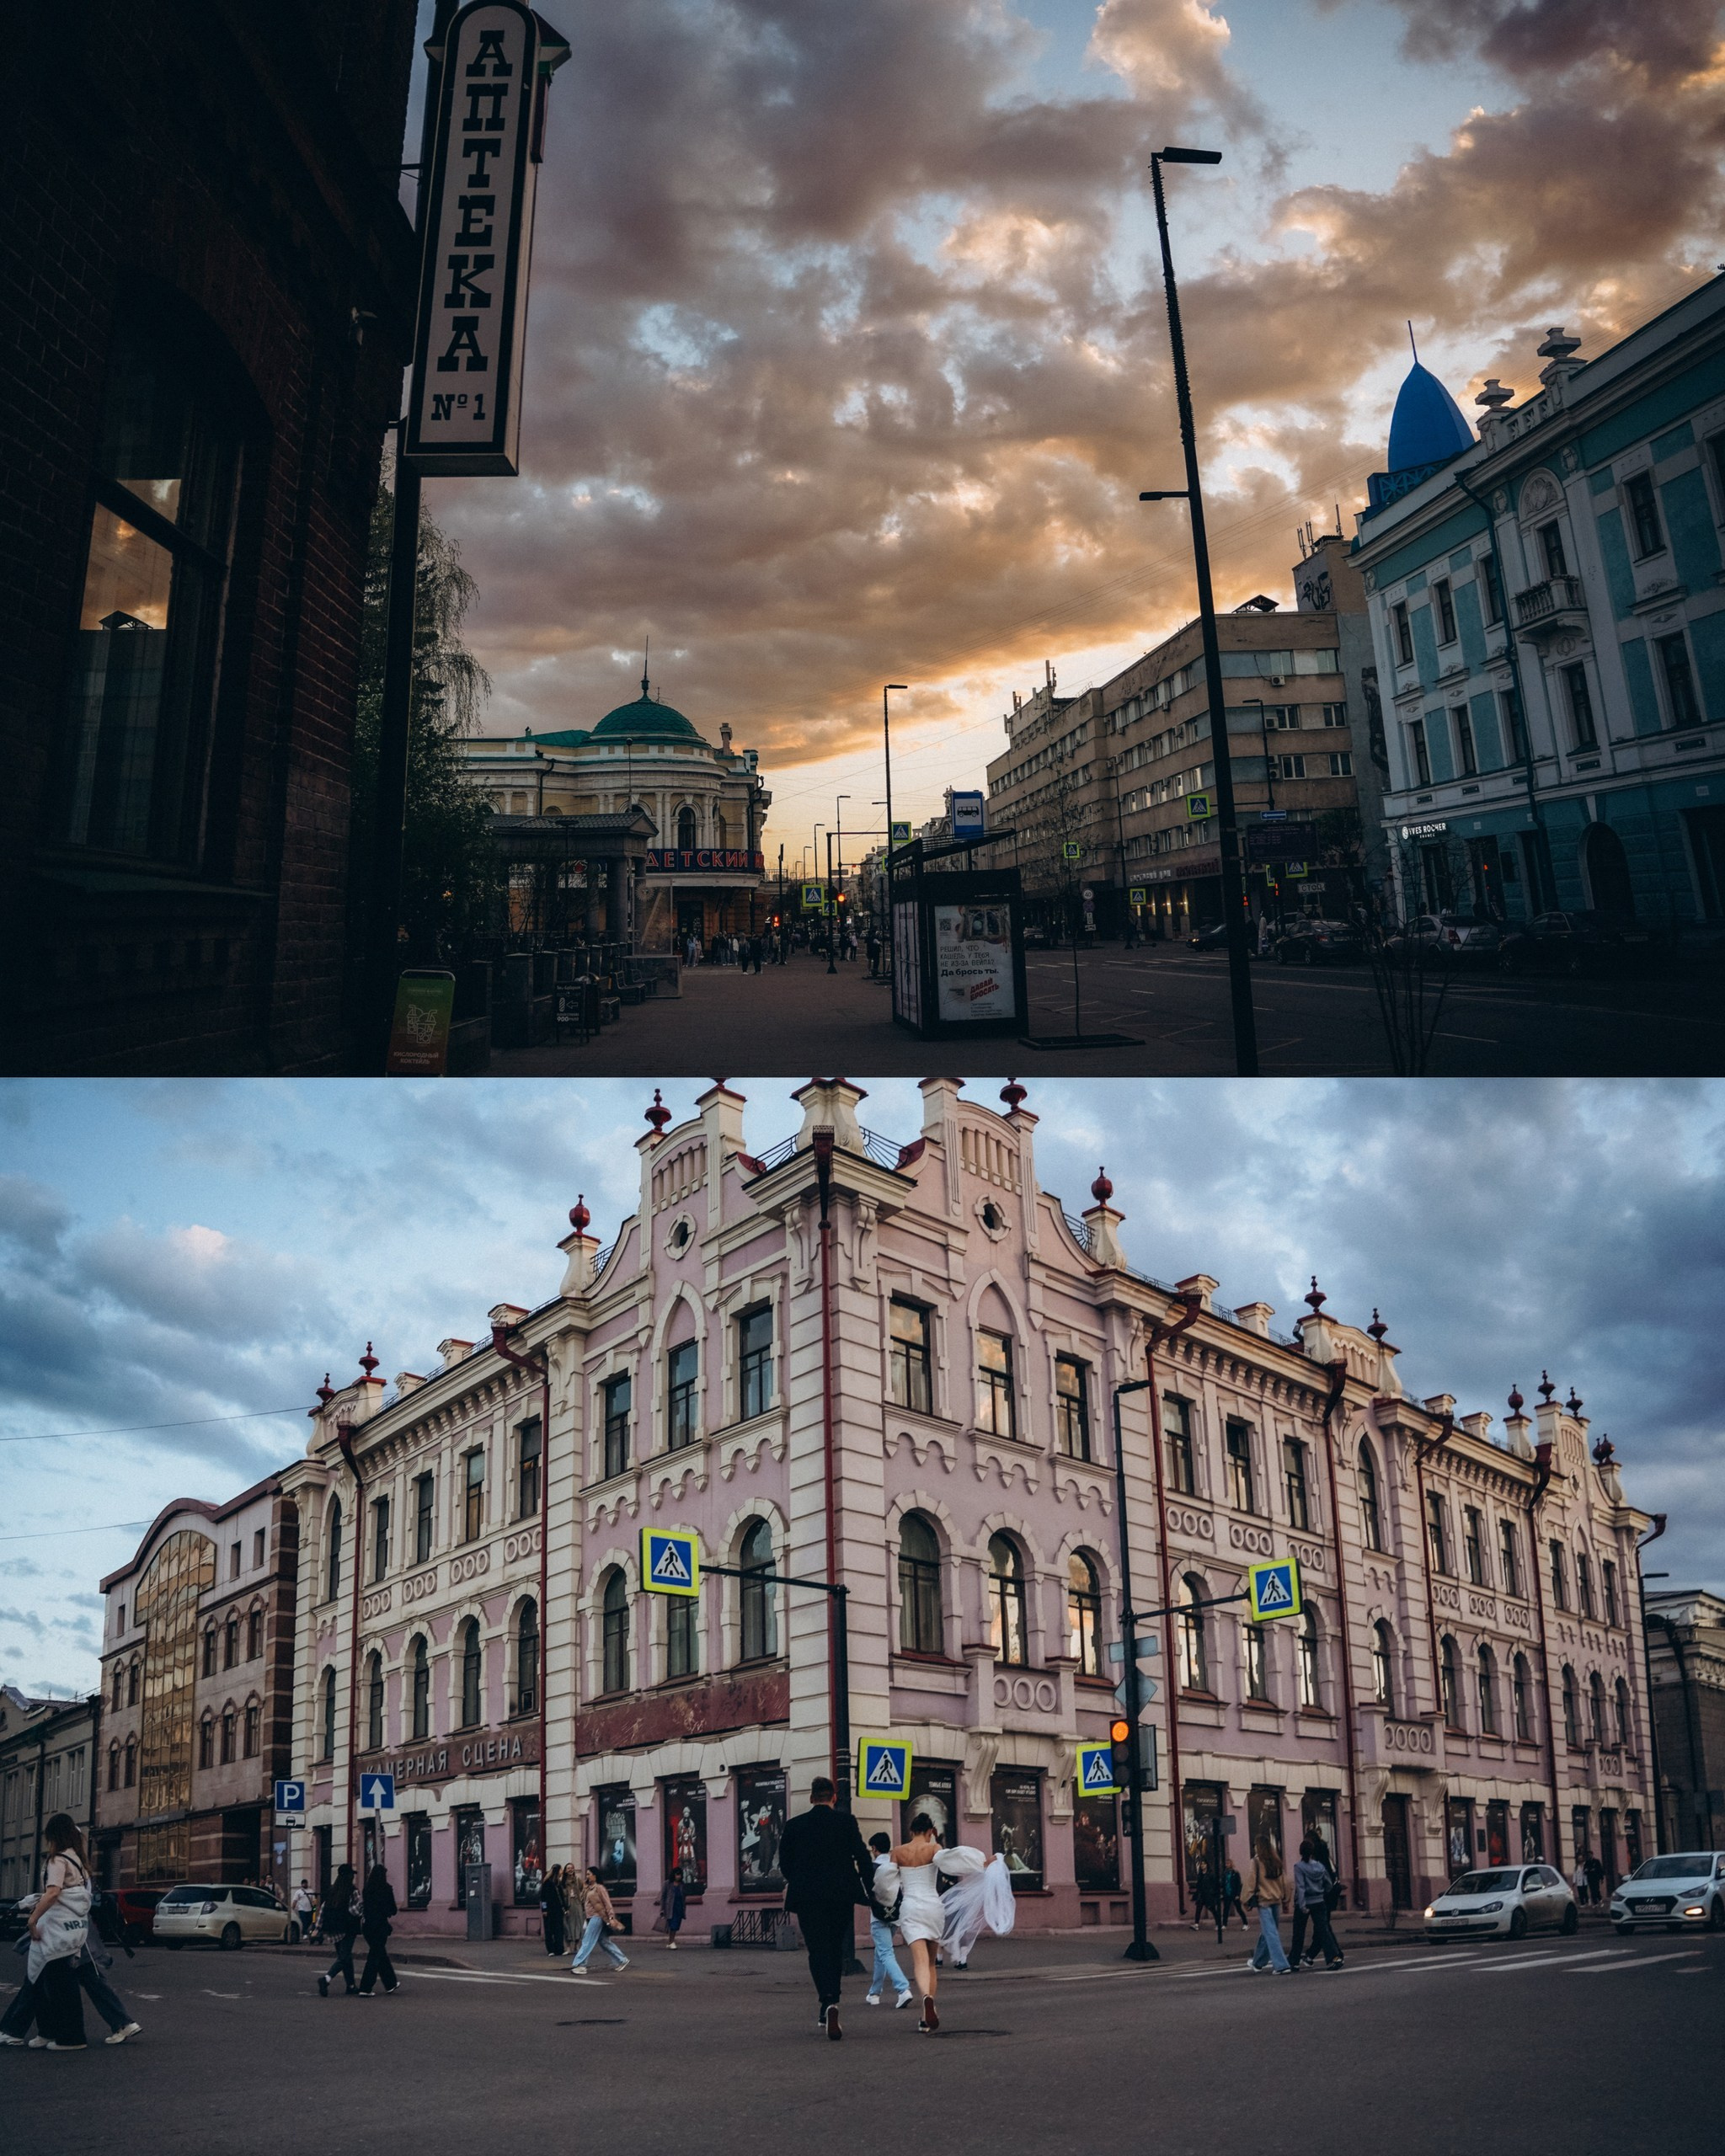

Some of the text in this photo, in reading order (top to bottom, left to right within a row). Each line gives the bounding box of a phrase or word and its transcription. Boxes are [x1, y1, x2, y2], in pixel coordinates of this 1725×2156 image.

[437, 30, 512, 372] АПТЕКА
[1423, 822, 1446, 833] ROCHER
[645, 849, 749, 868] ДЕТСКИЙ
[955, 969, 983, 977] брось
[970, 977, 993, 994] ДАВАЙ
[970, 983, 1000, 1001] БРОСАТЬ
[462, 1735, 522, 1768] СЦЕНА
[283, 1785, 301, 1807] P
